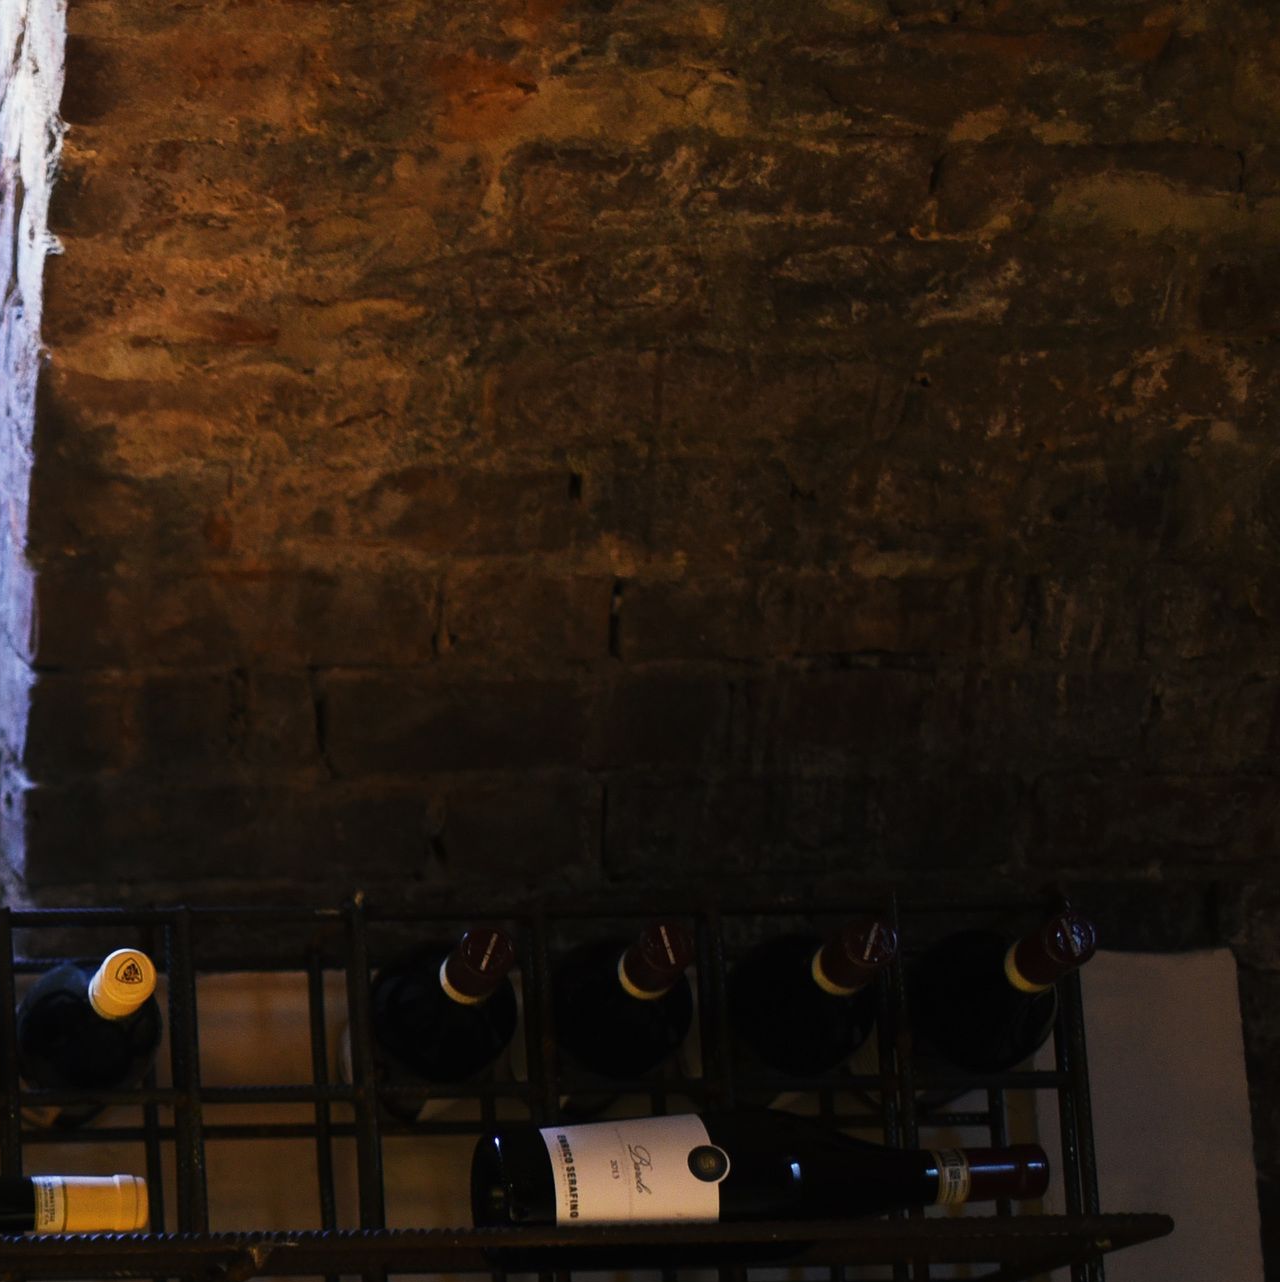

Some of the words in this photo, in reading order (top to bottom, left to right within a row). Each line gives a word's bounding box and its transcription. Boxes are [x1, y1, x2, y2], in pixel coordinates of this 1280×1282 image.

[557, 1134, 574, 1164] ENRICO
[566, 1166, 579, 1219] SERAFINO
[628, 1144, 653, 1196] Barolo
